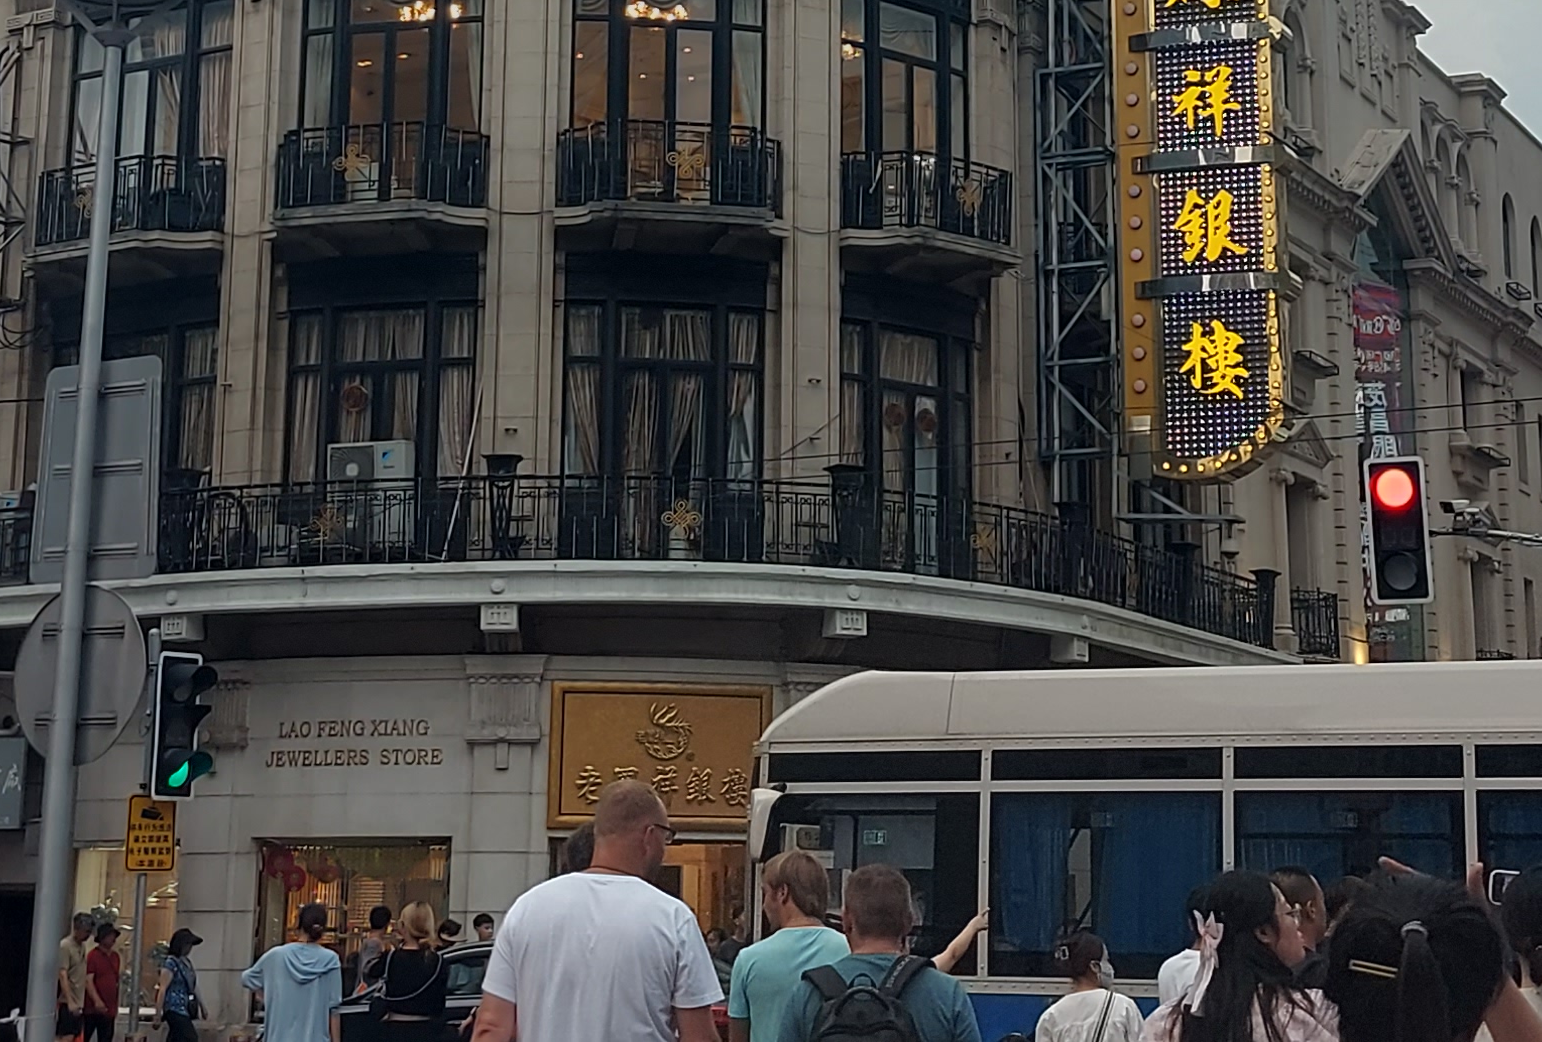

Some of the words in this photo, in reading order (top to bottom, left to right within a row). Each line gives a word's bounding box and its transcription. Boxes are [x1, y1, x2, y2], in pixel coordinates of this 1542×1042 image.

[279, 721, 312, 739] LAO
[317, 720, 366, 738] FENG
[370, 719, 430, 737] XIANG
[266, 750, 370, 768] JEWELLERS
[379, 749, 444, 766] STORE
